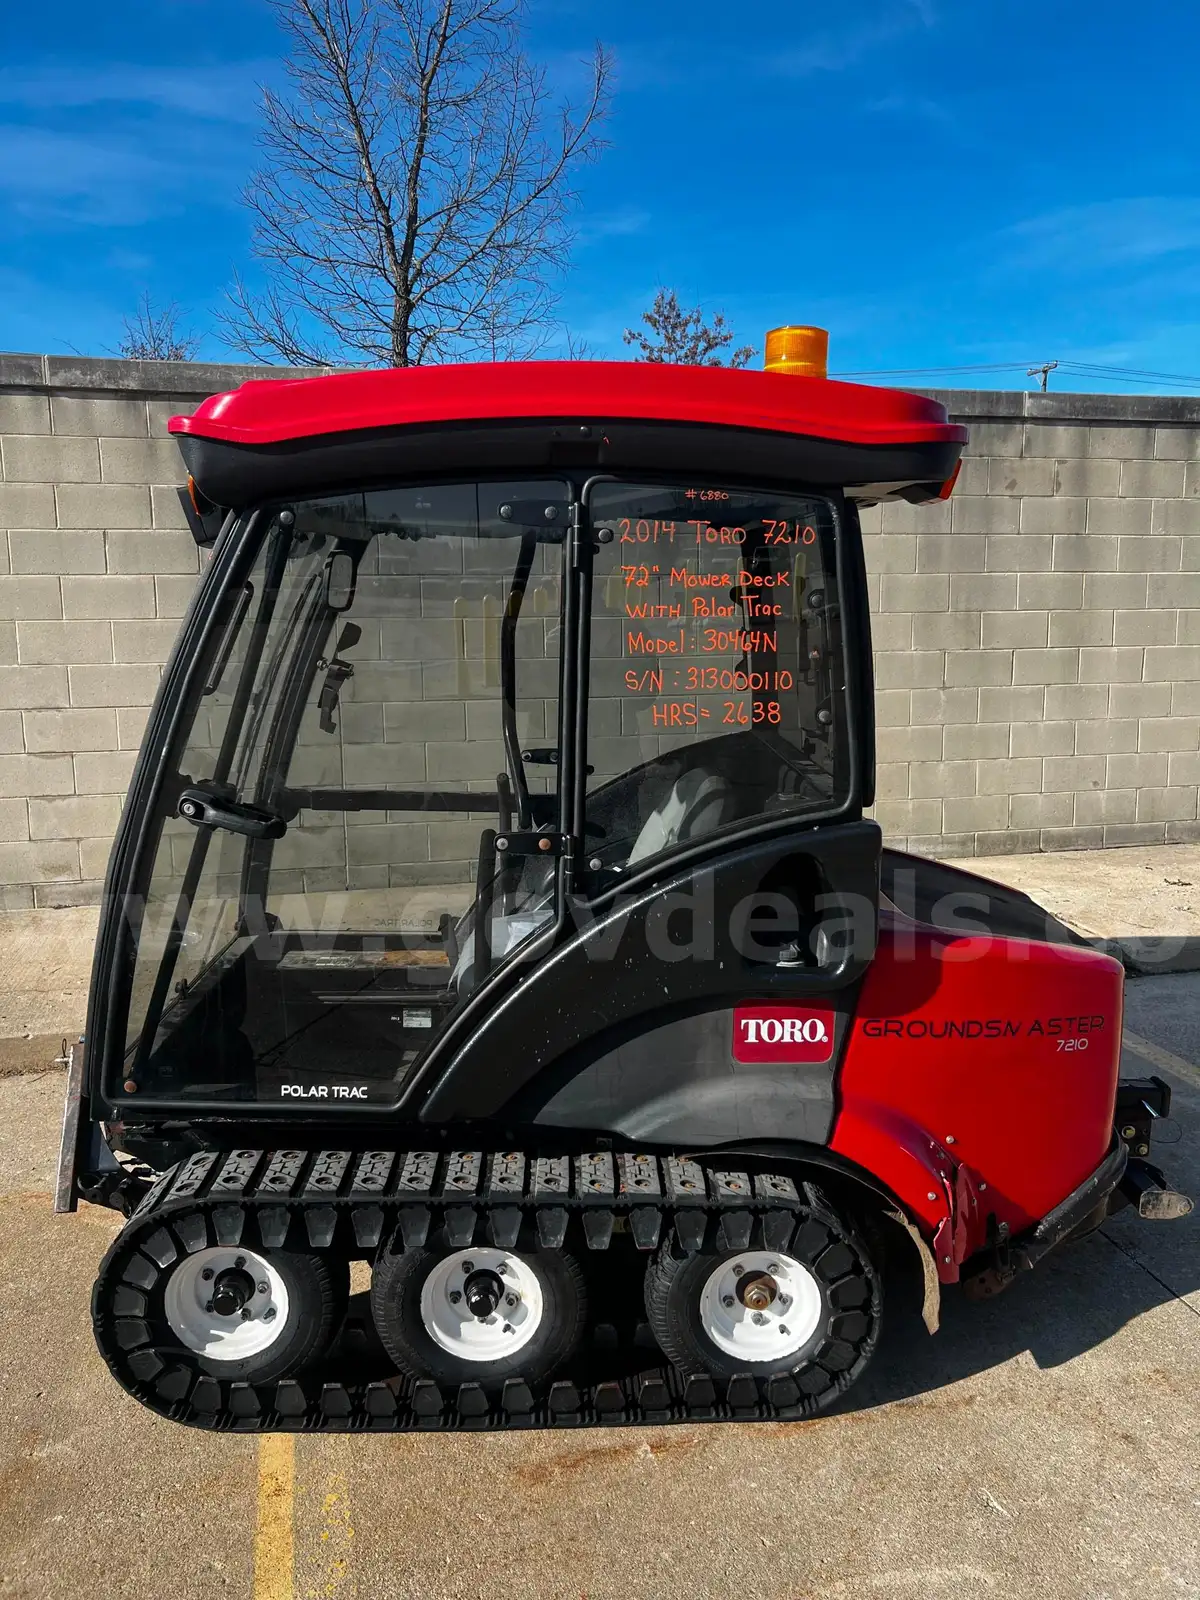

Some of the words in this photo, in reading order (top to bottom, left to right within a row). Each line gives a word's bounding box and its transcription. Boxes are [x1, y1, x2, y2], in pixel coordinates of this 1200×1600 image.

[618, 518, 676, 543] 2014
[762, 519, 816, 545] 7210
[620, 565, 659, 588] 72"
[692, 596, 735, 618] Polar
[740, 595, 782, 617] Trac
[702, 629, 777, 653] 30464N
[684, 666, 793, 691] 313000110
[722, 701, 781, 725] 2638
[1056, 1038, 1088, 1051] 7210
[281, 1085, 328, 1098] POLAR
[331, 1086, 368, 1098] TRAC
